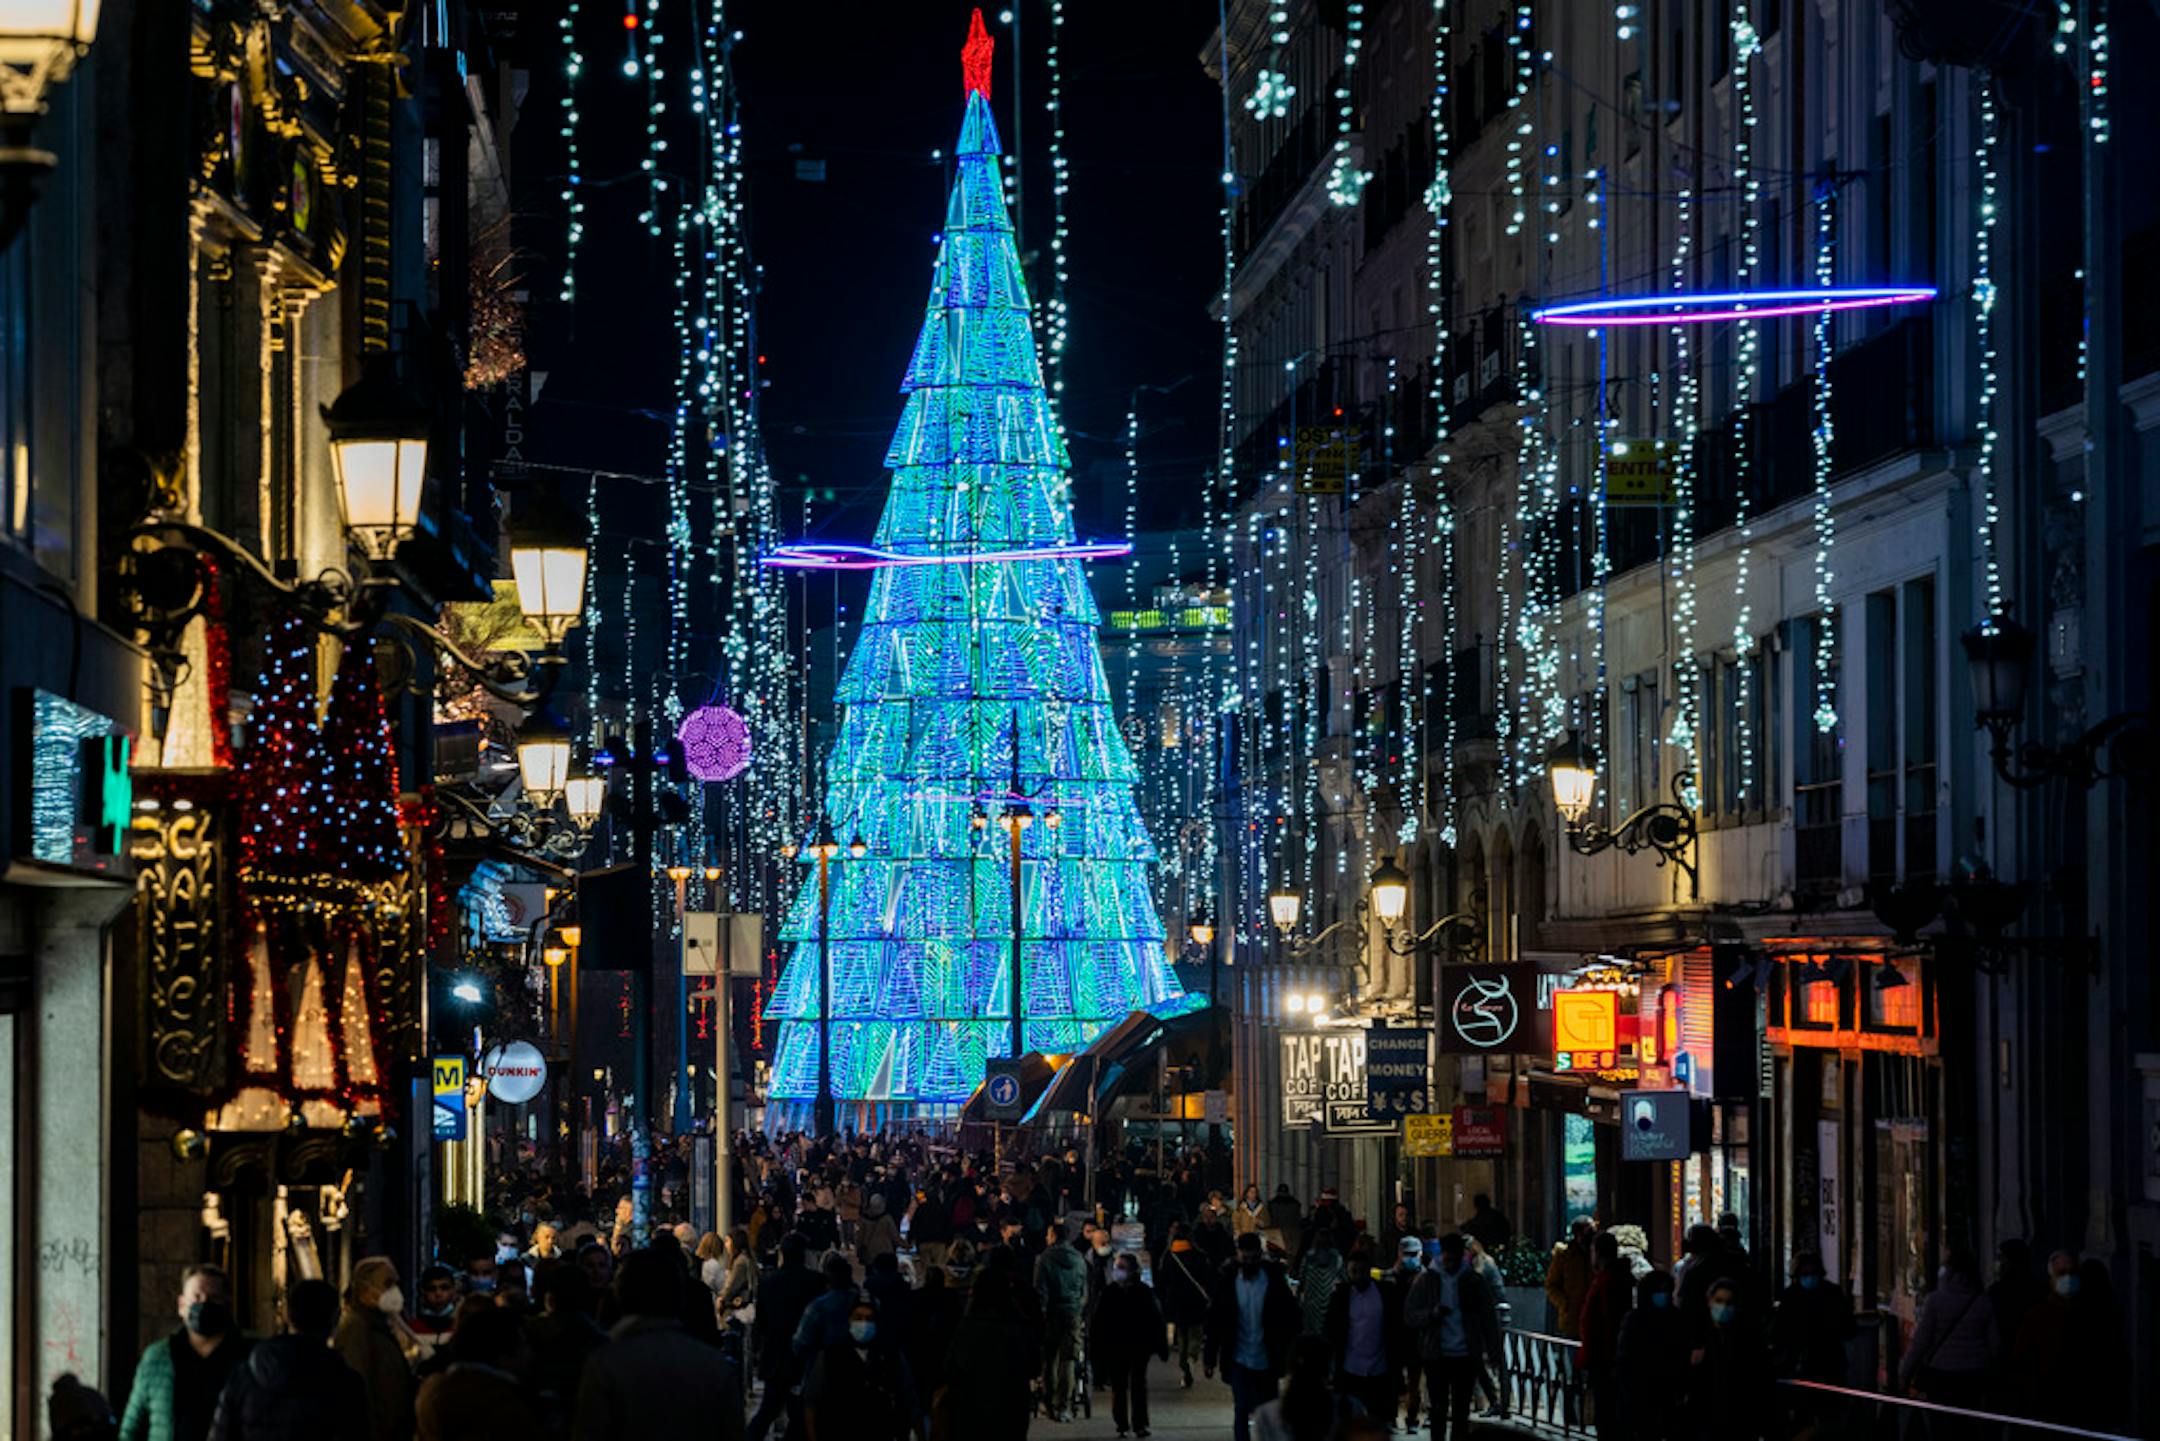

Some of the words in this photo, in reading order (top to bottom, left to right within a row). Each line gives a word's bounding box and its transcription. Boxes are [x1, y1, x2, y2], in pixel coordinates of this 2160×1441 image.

[1369, 1039, 1426, 1050] CHANGE
[1325, 1037, 1368, 1083] TAP
[487, 1066, 542, 1077] DUNKIN'
[1369, 1063, 1426, 1077] MONEY
[1467, 1127, 1491, 1135] LOCAL
